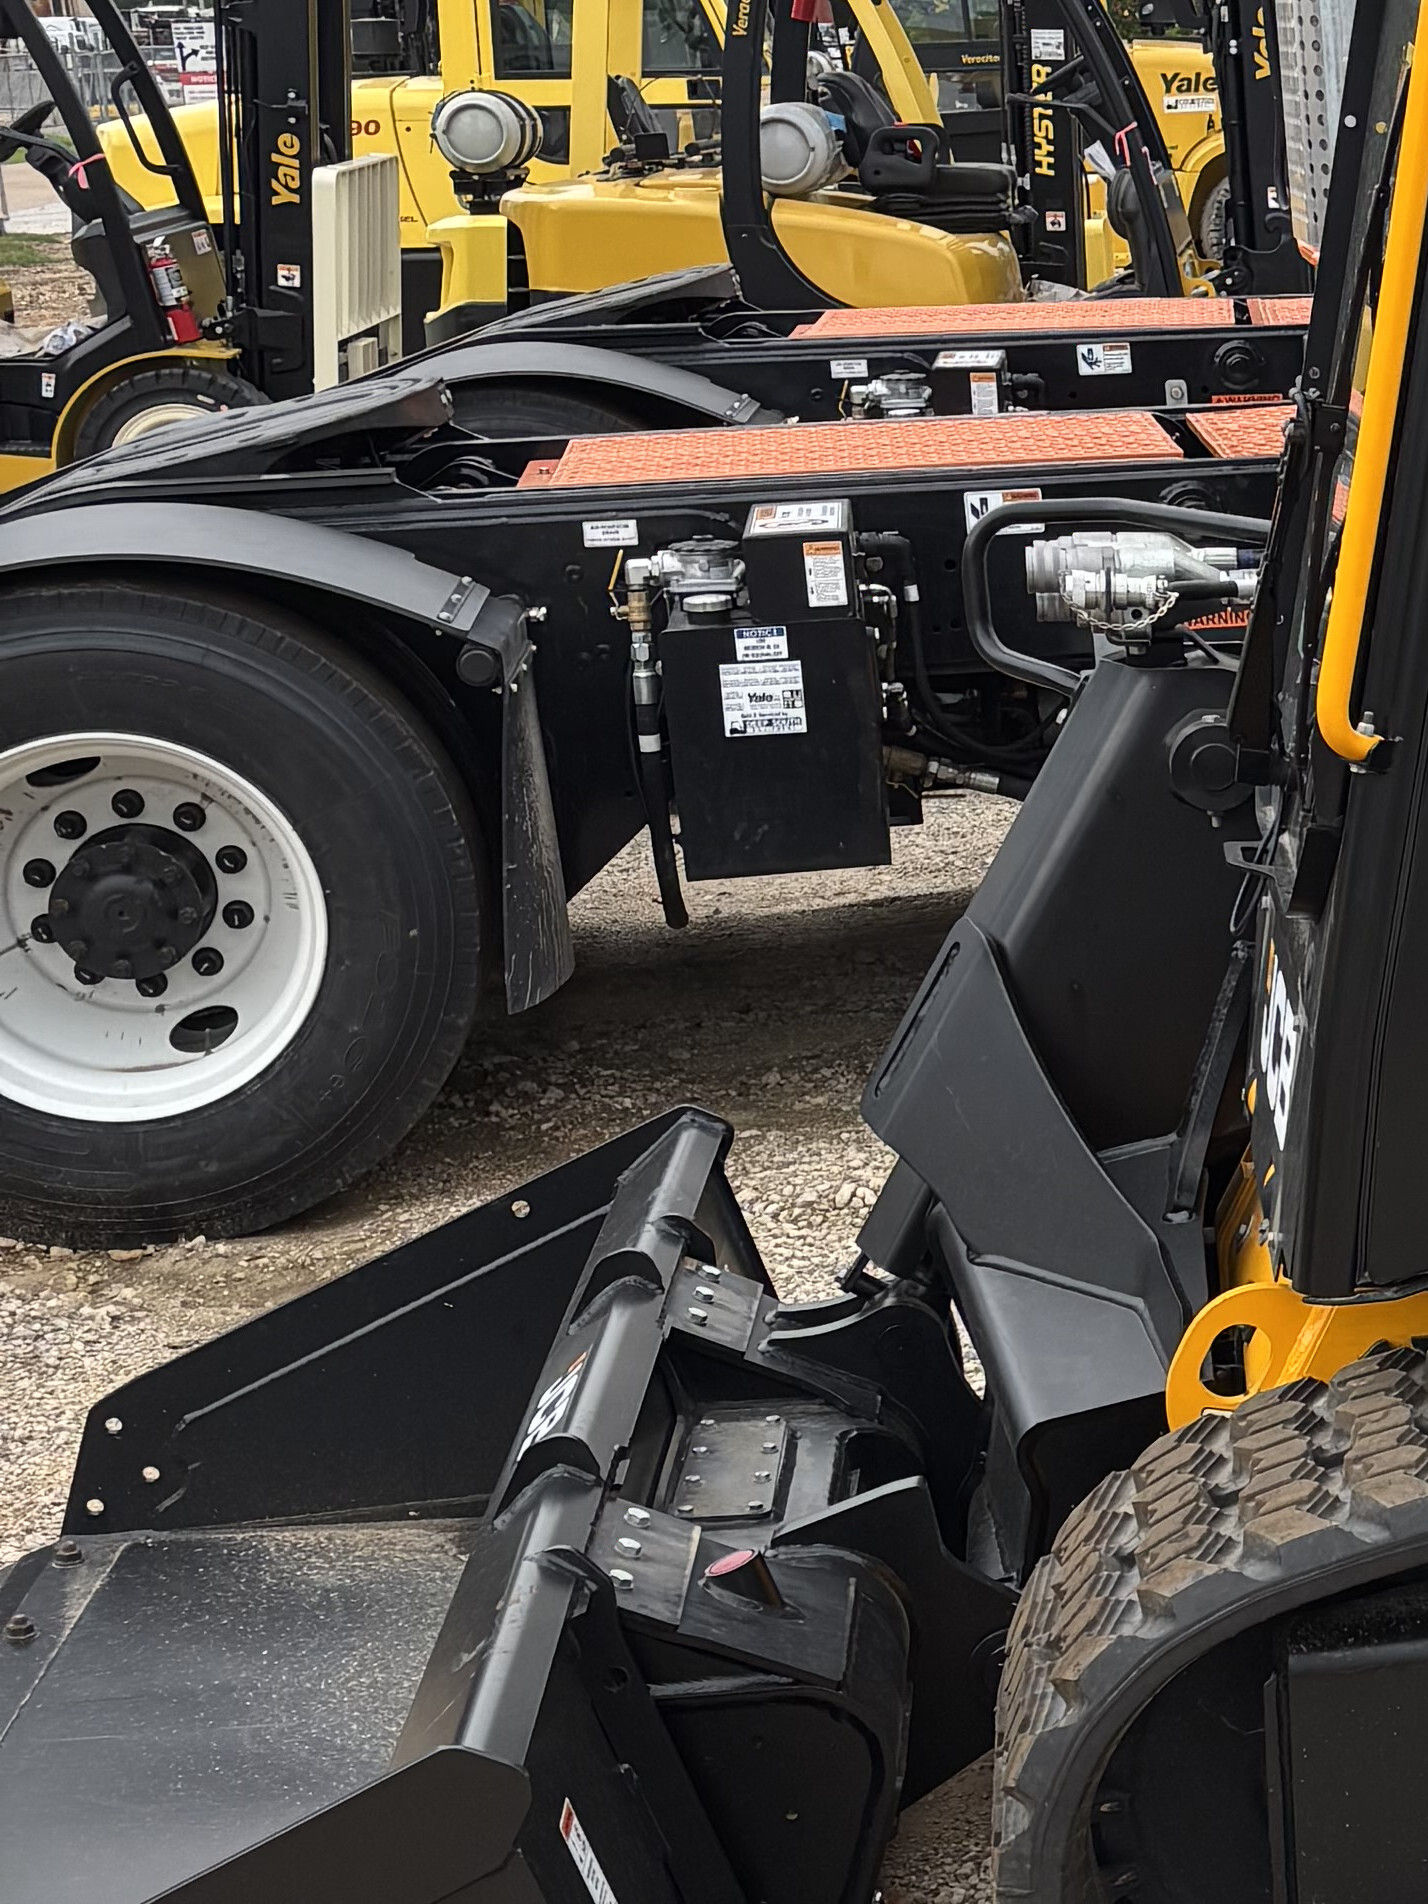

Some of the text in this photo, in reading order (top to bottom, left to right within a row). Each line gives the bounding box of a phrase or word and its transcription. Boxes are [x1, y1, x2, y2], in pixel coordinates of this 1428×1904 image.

[1160, 72, 1218, 94] Yale
[271, 132, 301, 206] Yale
[1188, 609, 1250, 626] ARNIN
[747, 693, 773, 704] Yale
[1260, 954, 1297, 1152] JCB
